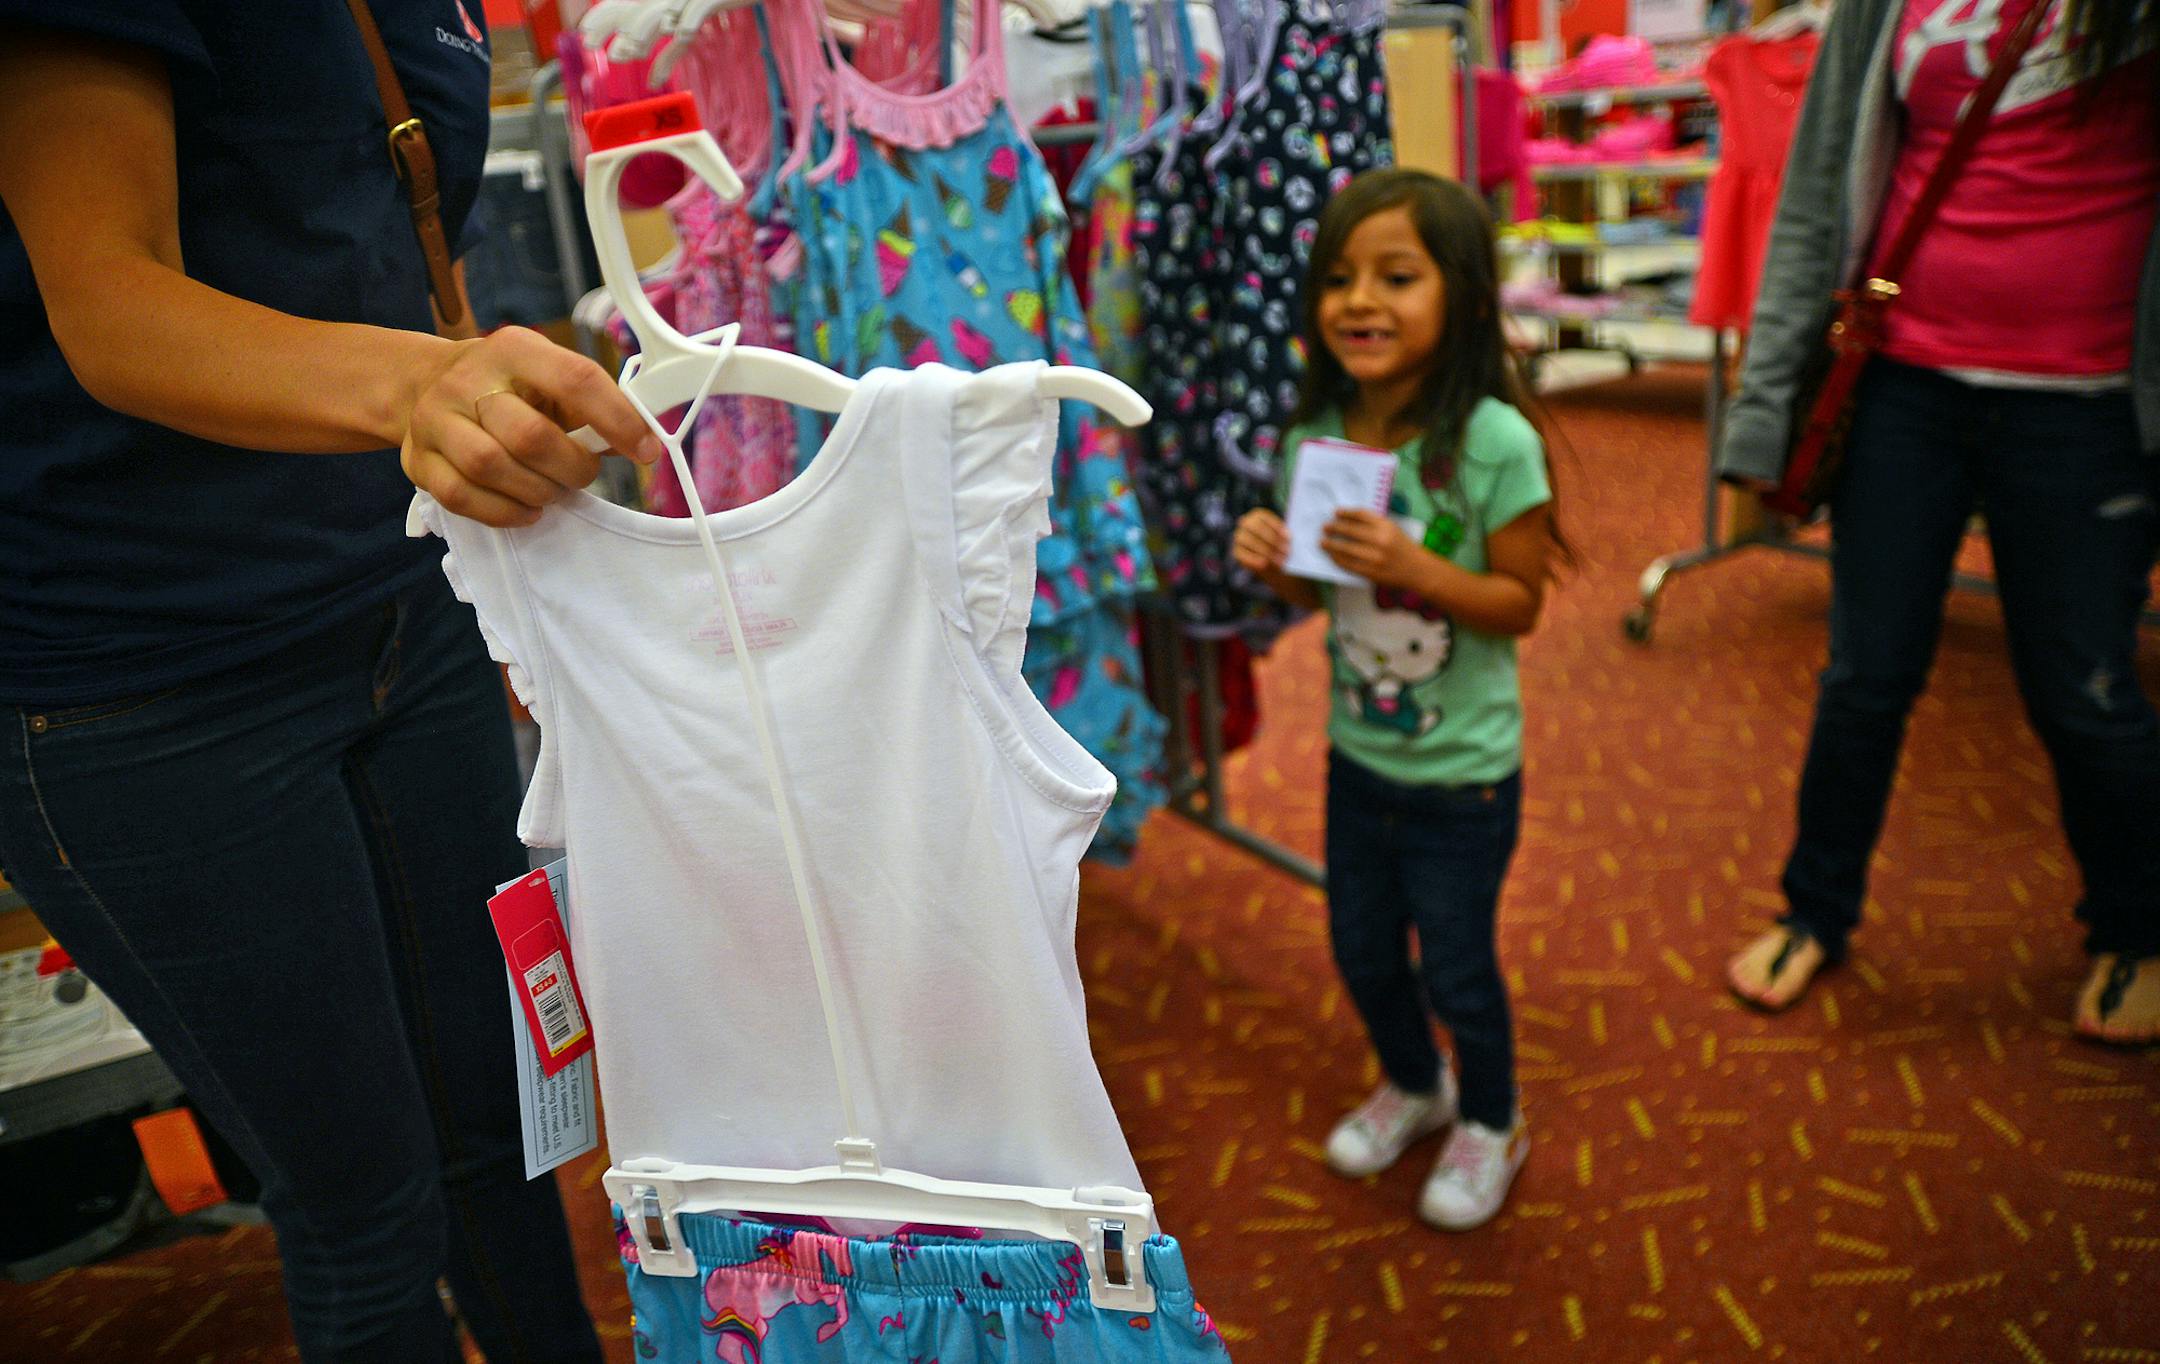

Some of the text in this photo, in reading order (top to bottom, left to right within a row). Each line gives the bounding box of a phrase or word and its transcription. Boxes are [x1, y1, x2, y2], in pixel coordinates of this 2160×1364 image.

[571, 1077, 579, 1102] Fabric
[551, 1105, 557, 1114] to
[551, 1115, 559, 1134] meet
